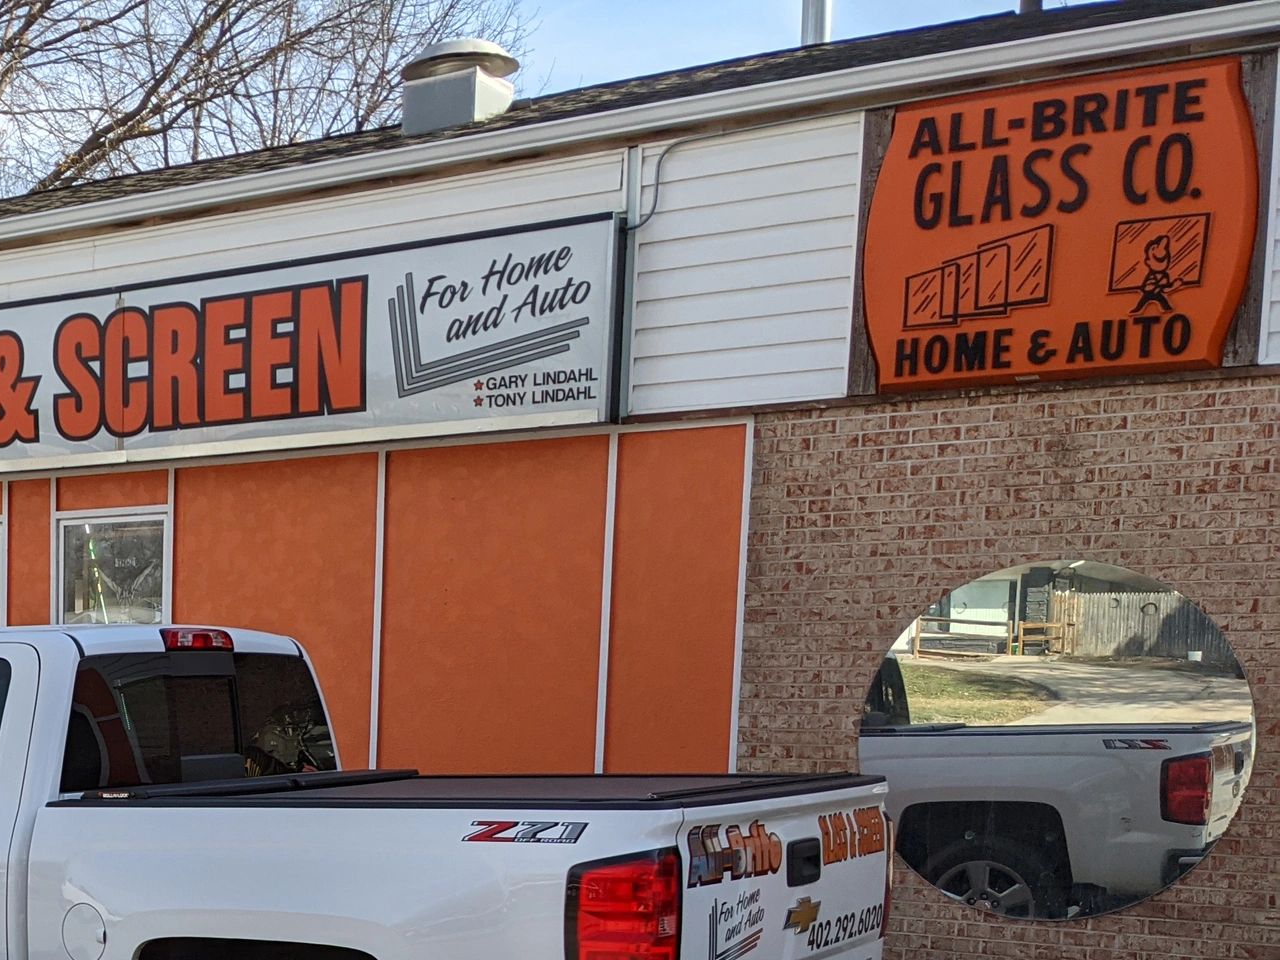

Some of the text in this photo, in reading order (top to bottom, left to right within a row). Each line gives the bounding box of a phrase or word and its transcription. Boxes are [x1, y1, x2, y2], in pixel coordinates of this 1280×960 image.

[908, 78, 1206, 158] ALL-BRITE
[913, 133, 1201, 229] GLASS CO.
[420, 246, 573, 314] For Home
[446, 277, 591, 342] and Auto
[53, 275, 369, 441] SCREEN
[894, 313, 1191, 377] HOME & AUTO
[486, 368, 598, 391] GARY LINDAHL
[486, 386, 596, 408] TONY LINDAHL
[461, 821, 589, 843] Z71
[687, 819, 782, 889] All-Brite
[818, 811, 848, 866] GLASS
[853, 806, 885, 857] SCREEN
[719, 888, 761, 925] For Home
[725, 907, 765, 942] and Auto
[807, 903, 883, 951] 402.292.6020
